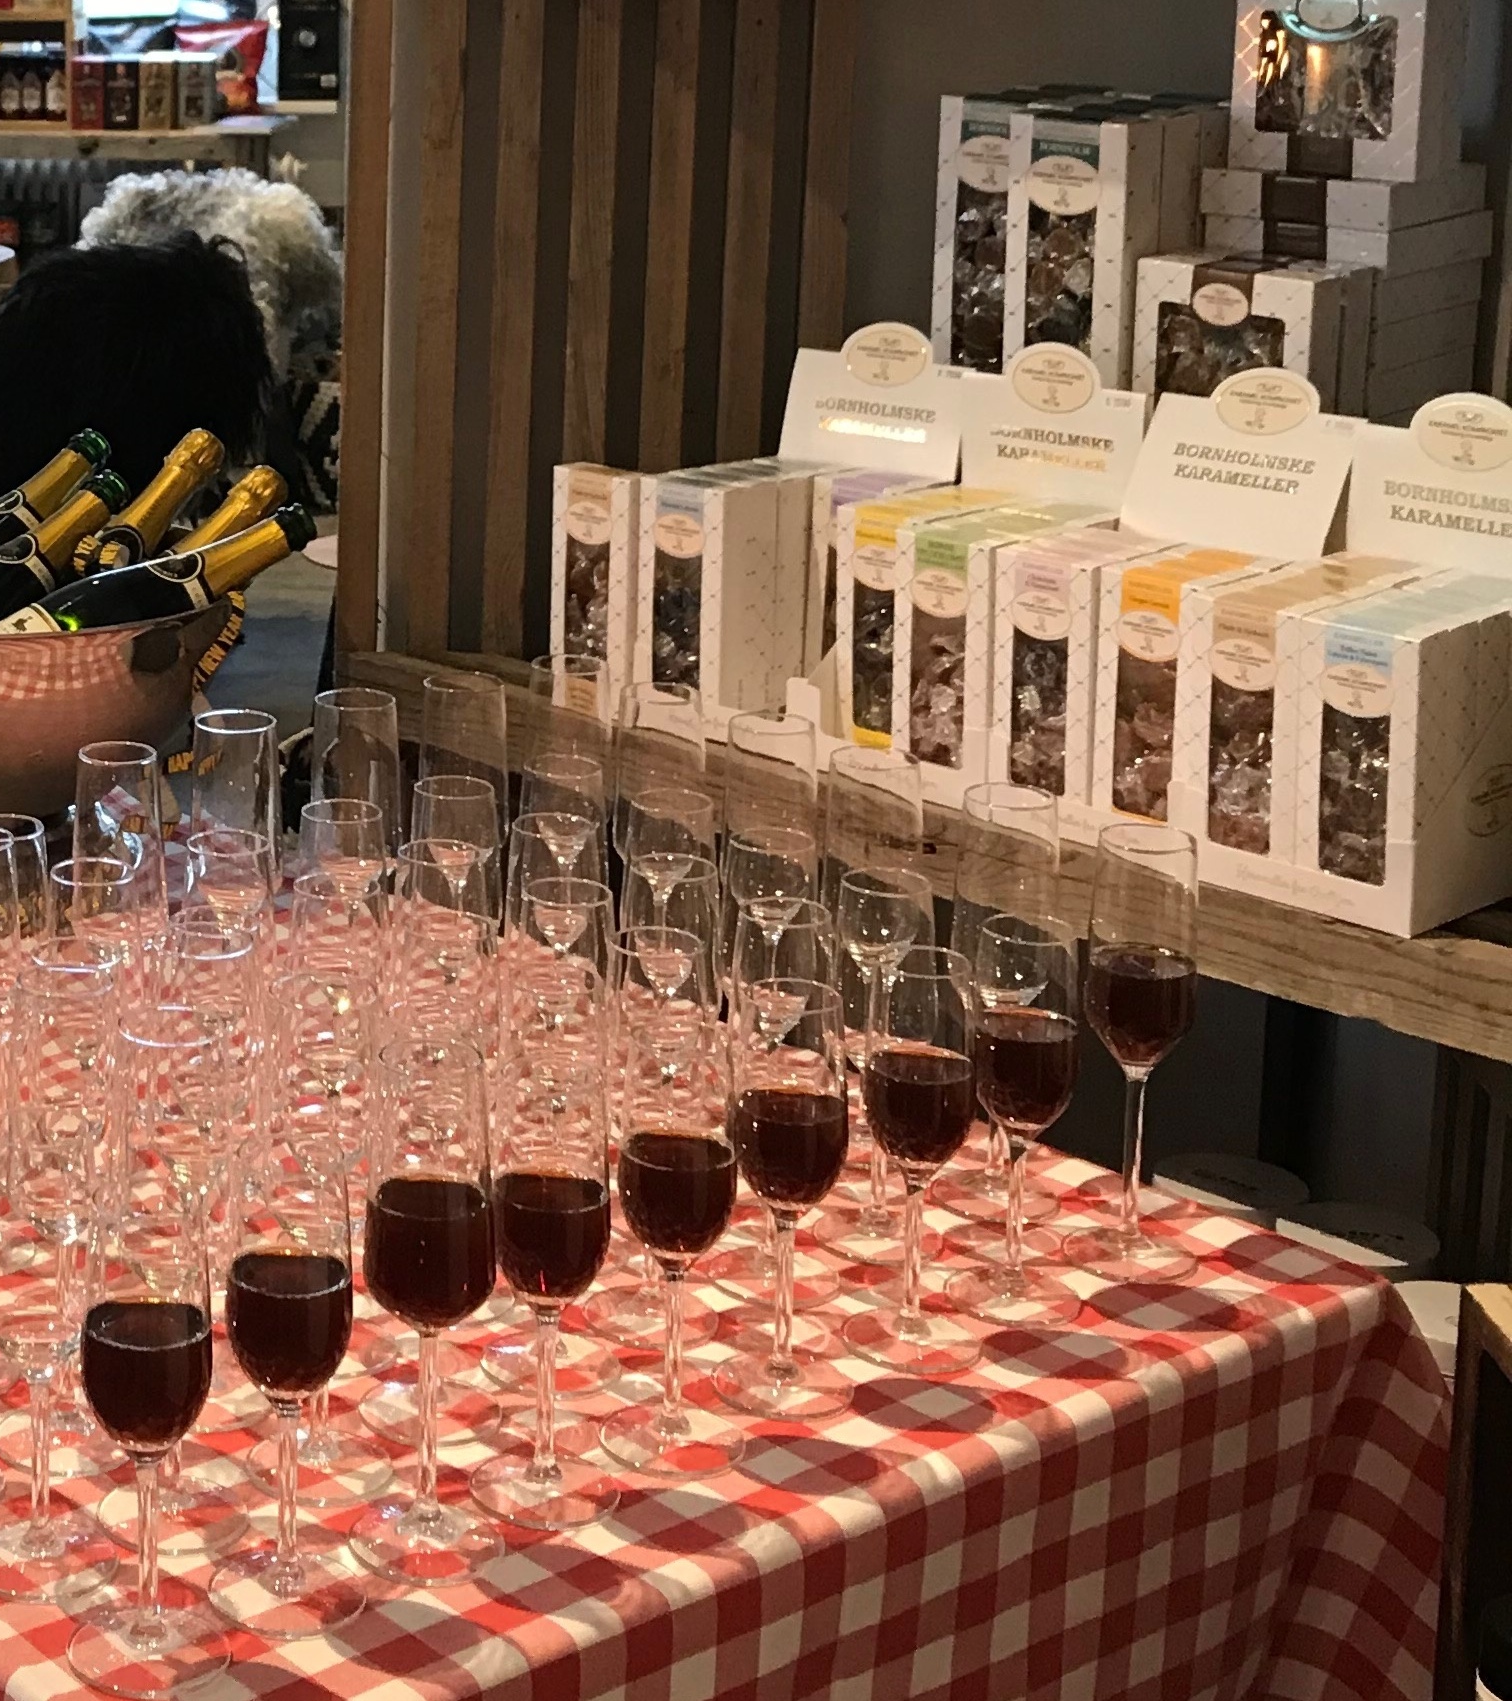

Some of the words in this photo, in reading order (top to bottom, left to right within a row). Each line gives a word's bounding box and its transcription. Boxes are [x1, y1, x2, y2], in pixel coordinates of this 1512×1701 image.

[814, 397, 936, 424] BORNHOLMSKE
[1173, 442, 1316, 475] BORNHOLMSKE
[1174, 463, 1300, 495] KARAMELLER
[1383, 479, 1512, 515] BORNHOLMS
